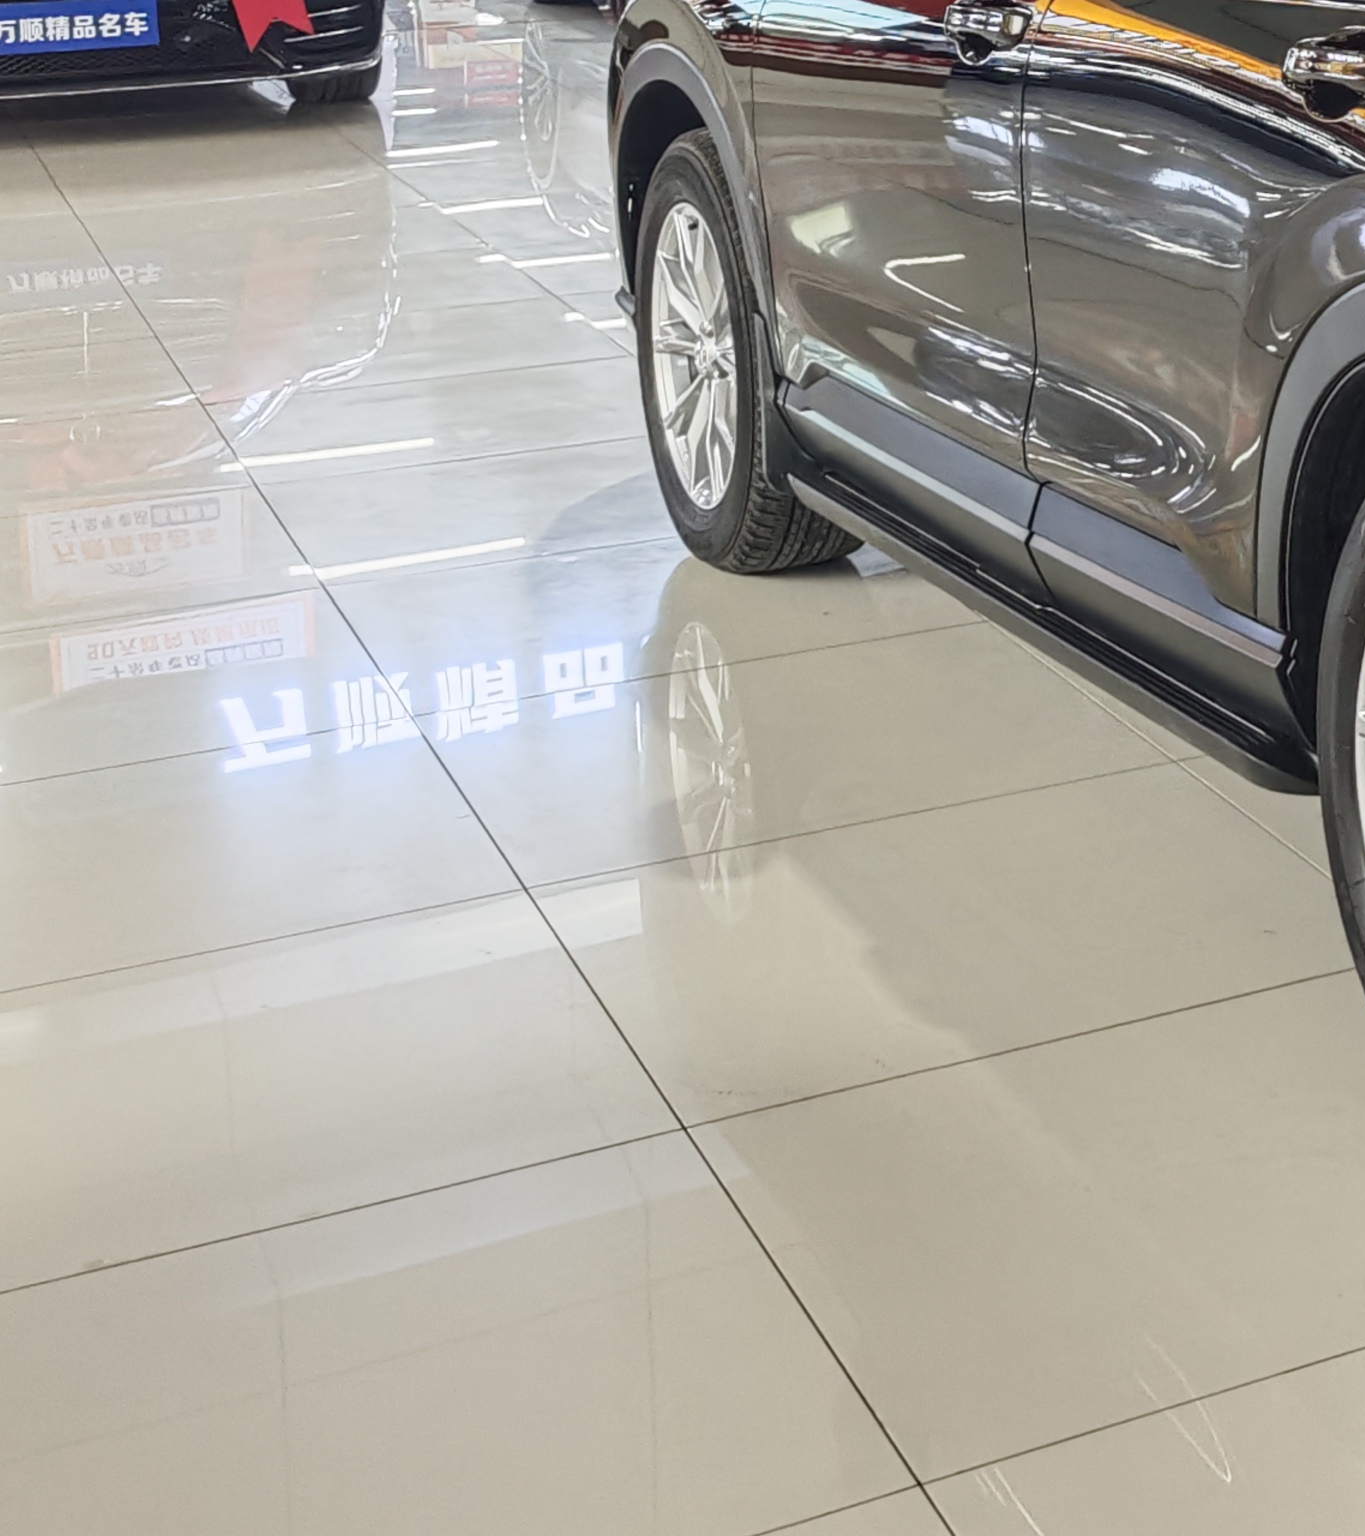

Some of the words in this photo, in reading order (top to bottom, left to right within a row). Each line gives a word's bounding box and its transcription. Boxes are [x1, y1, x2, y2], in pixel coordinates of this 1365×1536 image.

[0, 11, 150, 44] 万顺精品名车
